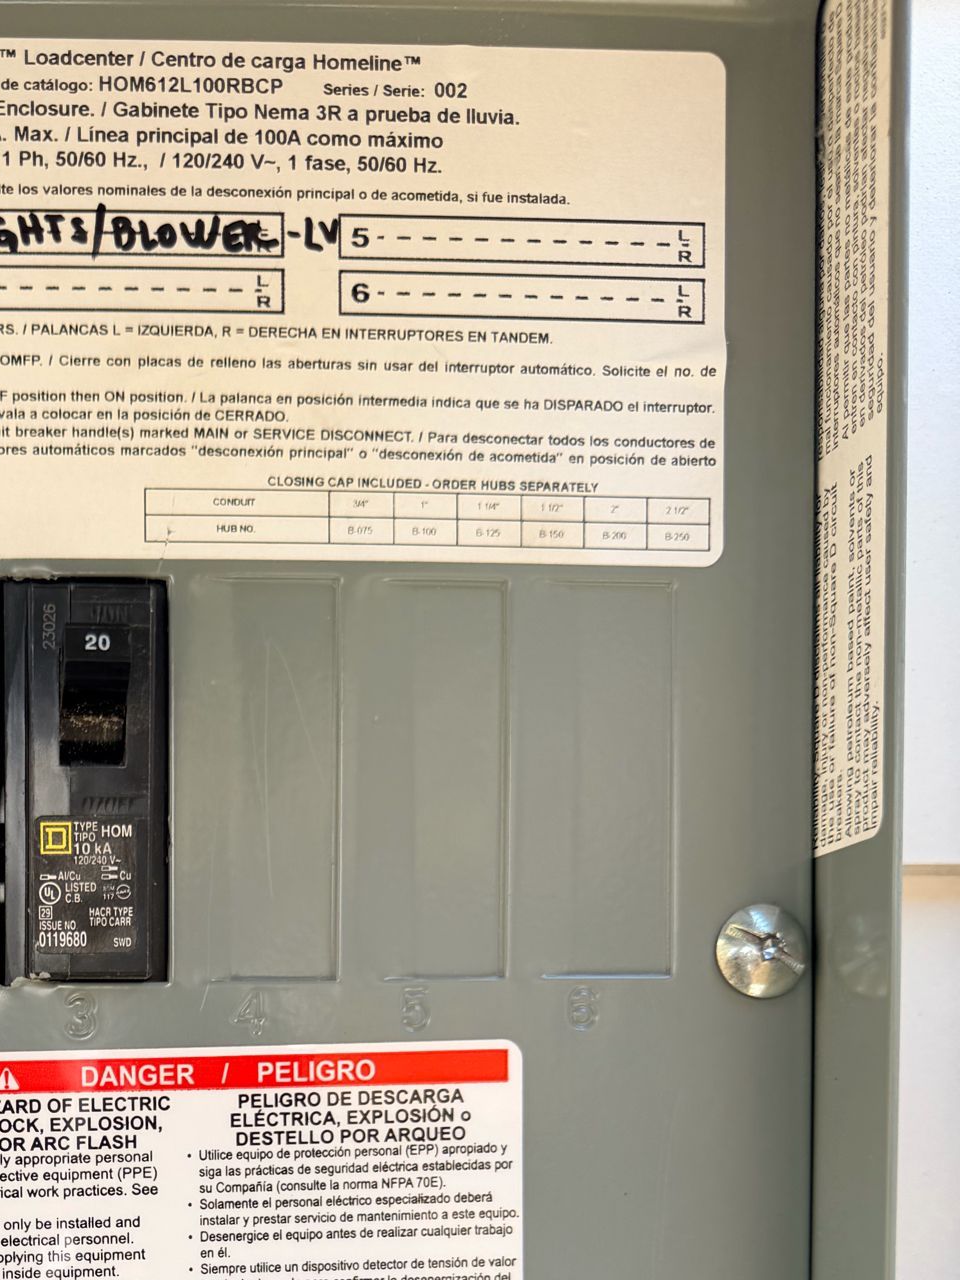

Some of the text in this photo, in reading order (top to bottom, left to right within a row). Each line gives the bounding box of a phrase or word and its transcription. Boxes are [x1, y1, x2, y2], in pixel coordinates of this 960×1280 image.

[24, 49, 134, 67] Loadcenter
[139, 51, 145, 66] /
[151, 51, 216, 68] Centro
[222, 52, 245, 68] de
[251, 56, 305, 73] carga
[1, 78, 19, 90] de
[24, 79, 93, 94] catálogo:
[99, 76, 283, 94] HOM612L100RBCP
[323, 82, 467, 98] Series / Serie: 002
[101, 101, 107, 117] /
[113, 101, 199, 118] Gabinete
[205, 103, 248, 123] Tipo
[255, 104, 309, 120] Nema
[316, 105, 342, 121] 3R
[347, 109, 358, 121] a
[366, 107, 431, 126] prueba
[437, 108, 460, 123] de
[467, 108, 519, 125] lluvia.
[15, 126, 58, 142] Max.
[65, 126, 71, 142] /
[77, 126, 129, 143] Línea
[137, 127, 218, 148] principal
[224, 129, 248, 144] de
[255, 129, 301, 146] 100A
[307, 133, 361, 147] como
[368, 131, 443, 148] máximo
[351, 227, 370, 249] 5
[351, 283, 371, 304] 6
[268, 476, 325, 487] CLOSING
[328, 477, 354, 488] CAP
[358, 477, 422, 489] INCLUDED
[432, 479, 476, 490] ORDER
[481, 480, 515, 491] HUBS
[519, 480, 599, 493] SEPARATELY
[213, 497, 256, 506] CONDUIT
[84, 634, 111, 651] 20
[846, 677, 854, 762] petroleum
[74, 821, 98, 831] TYPE
[101, 824, 133, 838] HOM
[74, 832, 96, 842] TIPO
[74, 842, 112, 855] 10 kA
[39, 931, 87, 947] 0119680
[82, 1064, 194, 1087] DANGER
[258, 1059, 376, 1083] PELIGRO
[47, 1098, 72, 1113] OF
[79, 1096, 170, 1112] ELECTRIC
[238, 1089, 464, 1109] PELIGRO DE DESCARGA
[50, 1115, 162, 1133] EXPLOSION,
[230, 1104, 471, 1128] ELÉCTRICA, EXPLOSIÓN o
[30, 1136, 70, 1151] ARC
[77, 1135, 137, 1150] FLASH
[236, 1126, 466, 1146] DESTELLO POR ARQUEO
